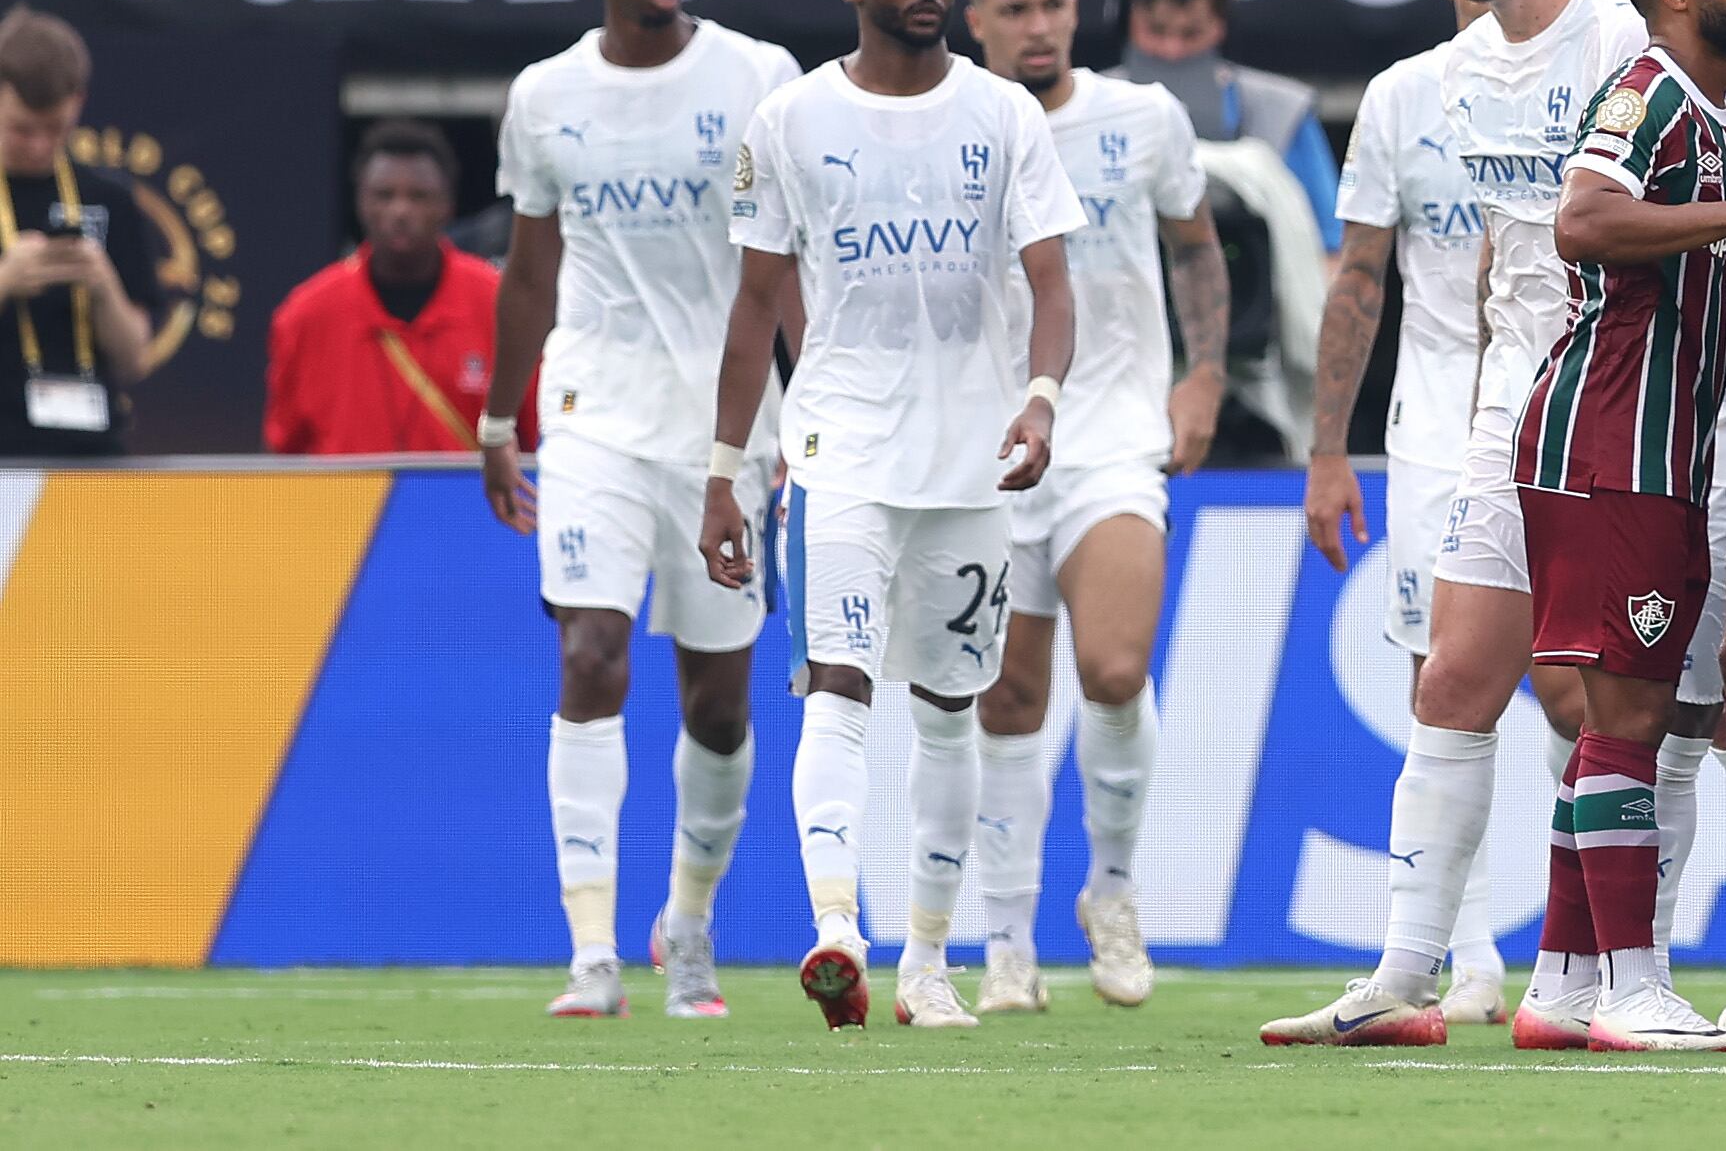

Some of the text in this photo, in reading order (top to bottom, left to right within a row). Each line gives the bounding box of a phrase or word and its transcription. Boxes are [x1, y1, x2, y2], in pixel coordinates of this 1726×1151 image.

[573, 178, 712, 218] SAVVY
[1700, 174, 1723, 184] umbro
[834, 217, 981, 264] SAVVY
[946, 560, 1010, 637] 24
